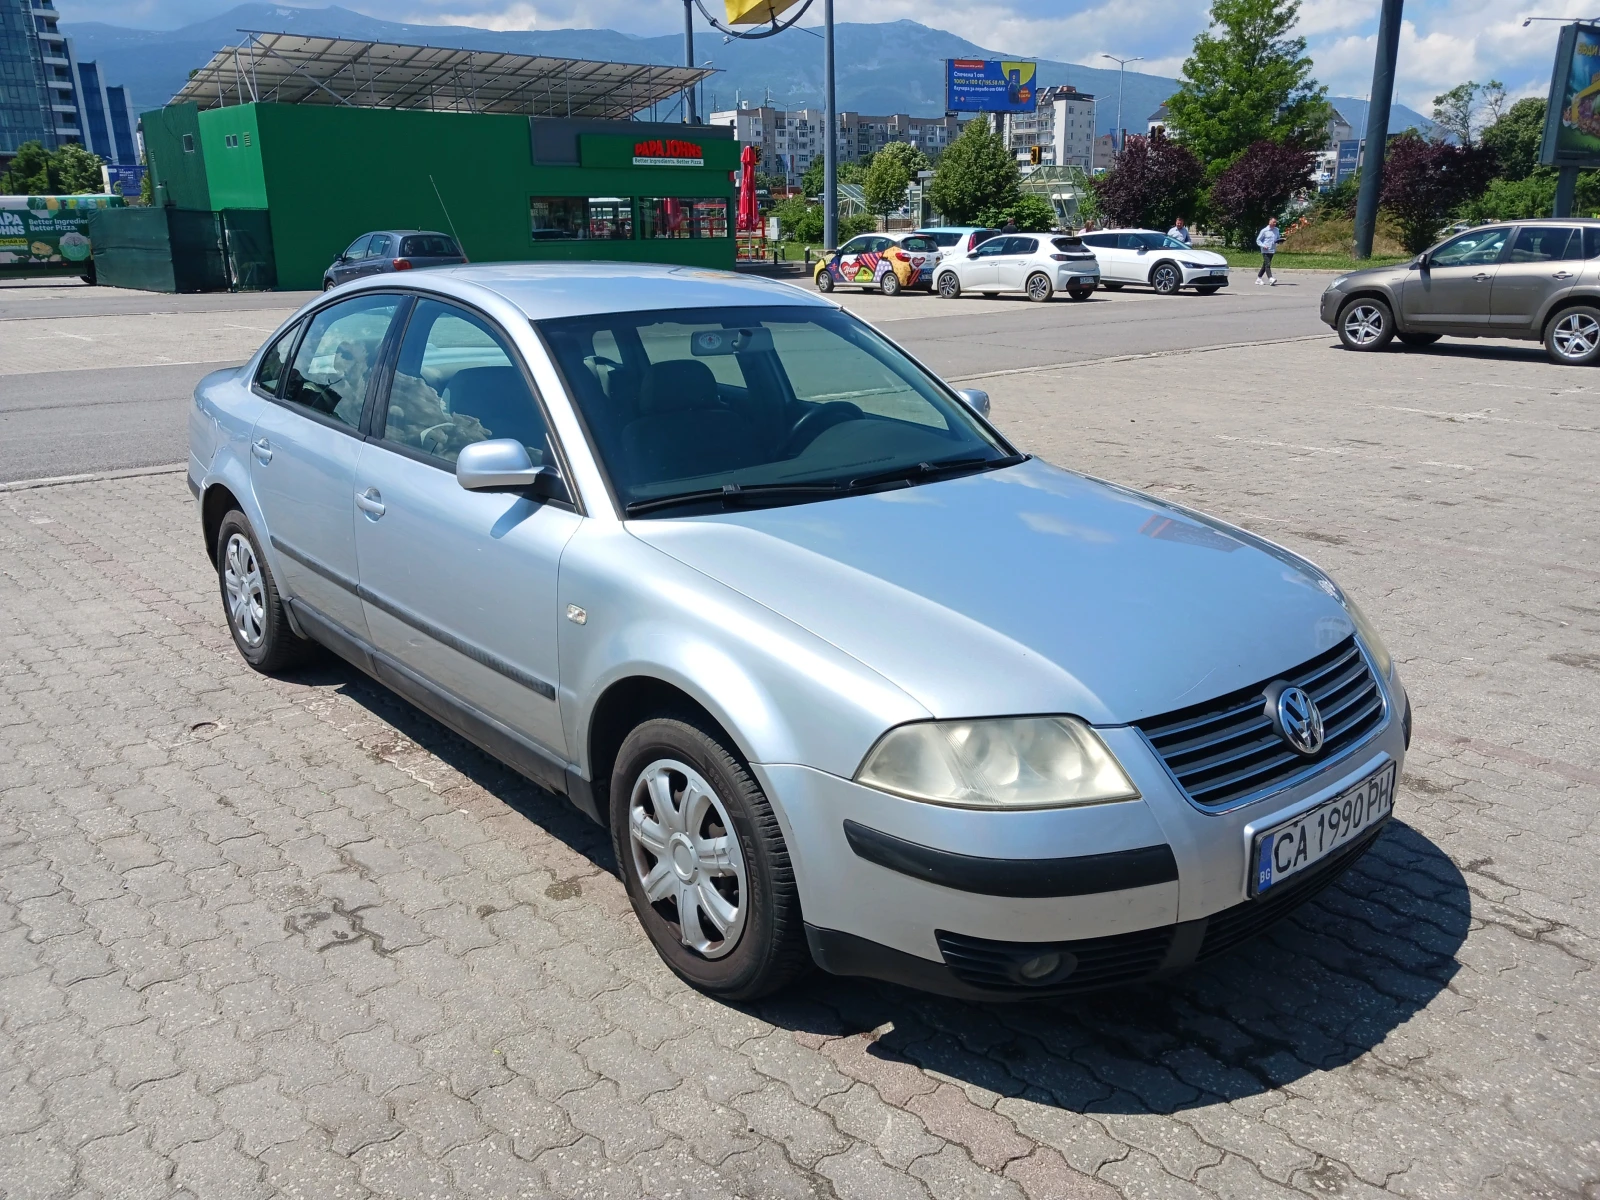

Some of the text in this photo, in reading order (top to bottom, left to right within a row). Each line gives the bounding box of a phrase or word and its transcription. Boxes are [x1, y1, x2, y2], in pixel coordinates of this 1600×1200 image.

[634, 139, 703, 158] PAPA JOHNS
[1274, 771, 1391, 873] CA 1990 PH
[1259, 868, 1271, 884] BG
